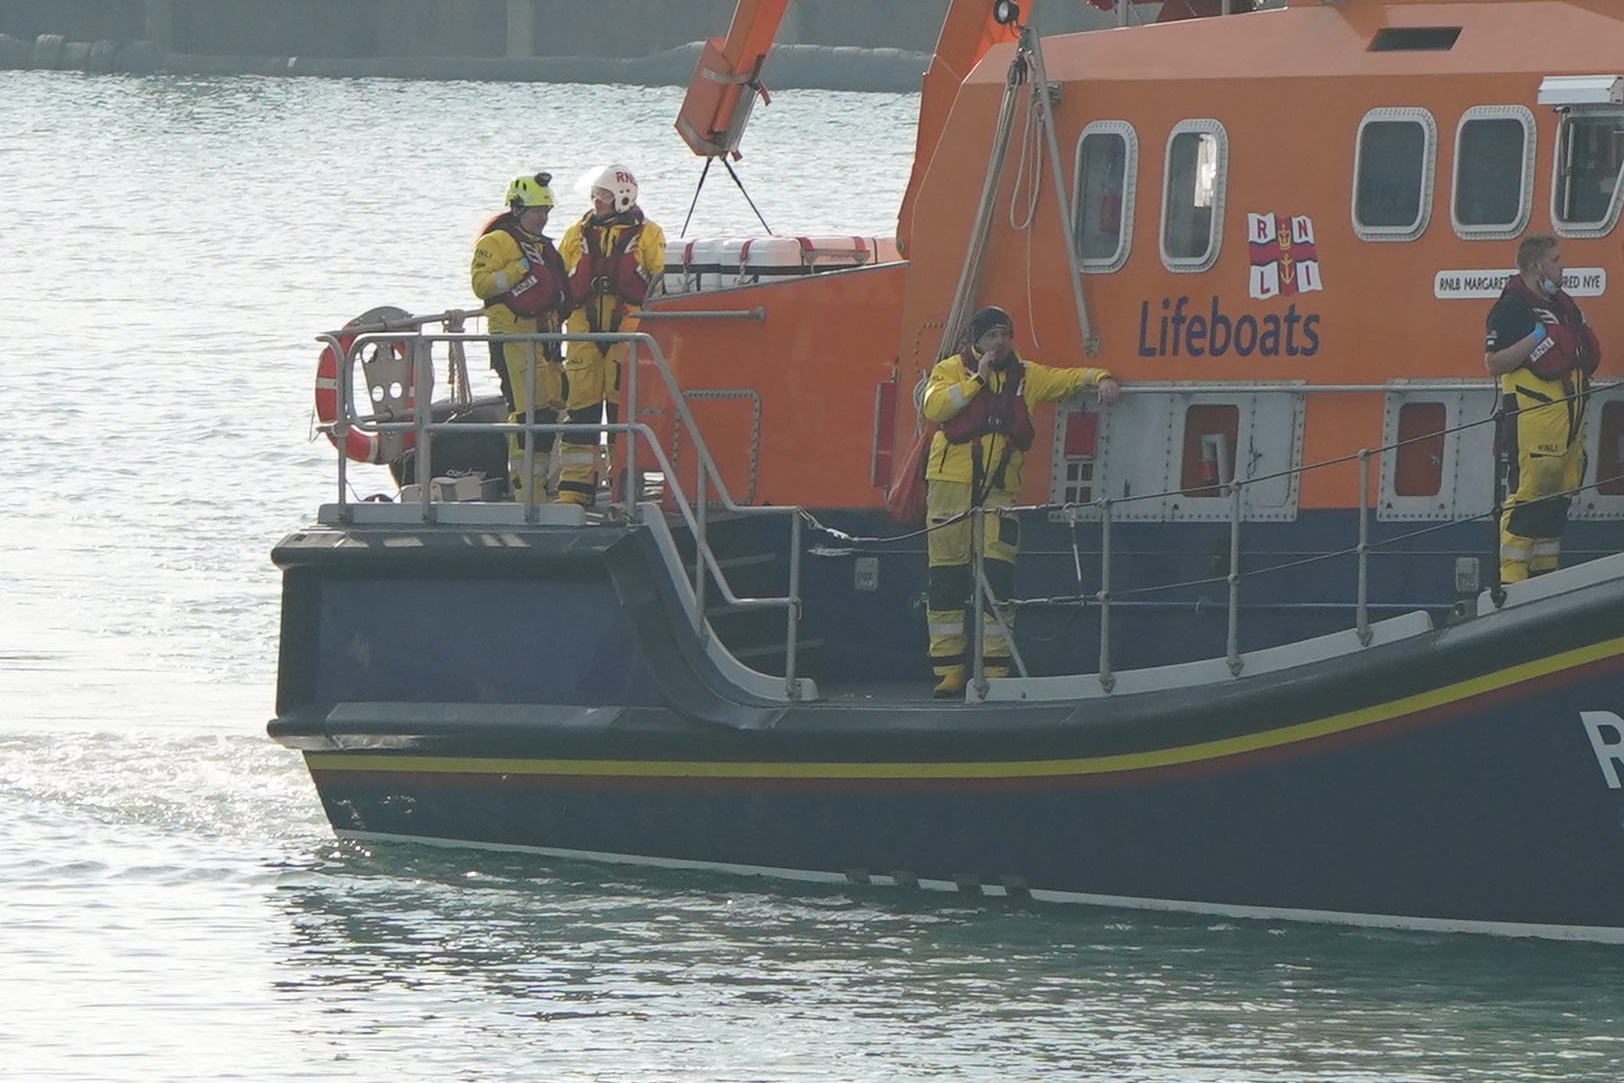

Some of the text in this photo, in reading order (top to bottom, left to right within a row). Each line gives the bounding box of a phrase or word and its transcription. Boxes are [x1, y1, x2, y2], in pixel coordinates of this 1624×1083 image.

[1439, 278, 1461, 291] RNLB
[1583, 274, 1601, 288] NYE
[1138, 295, 1321, 358] Lifeboats
